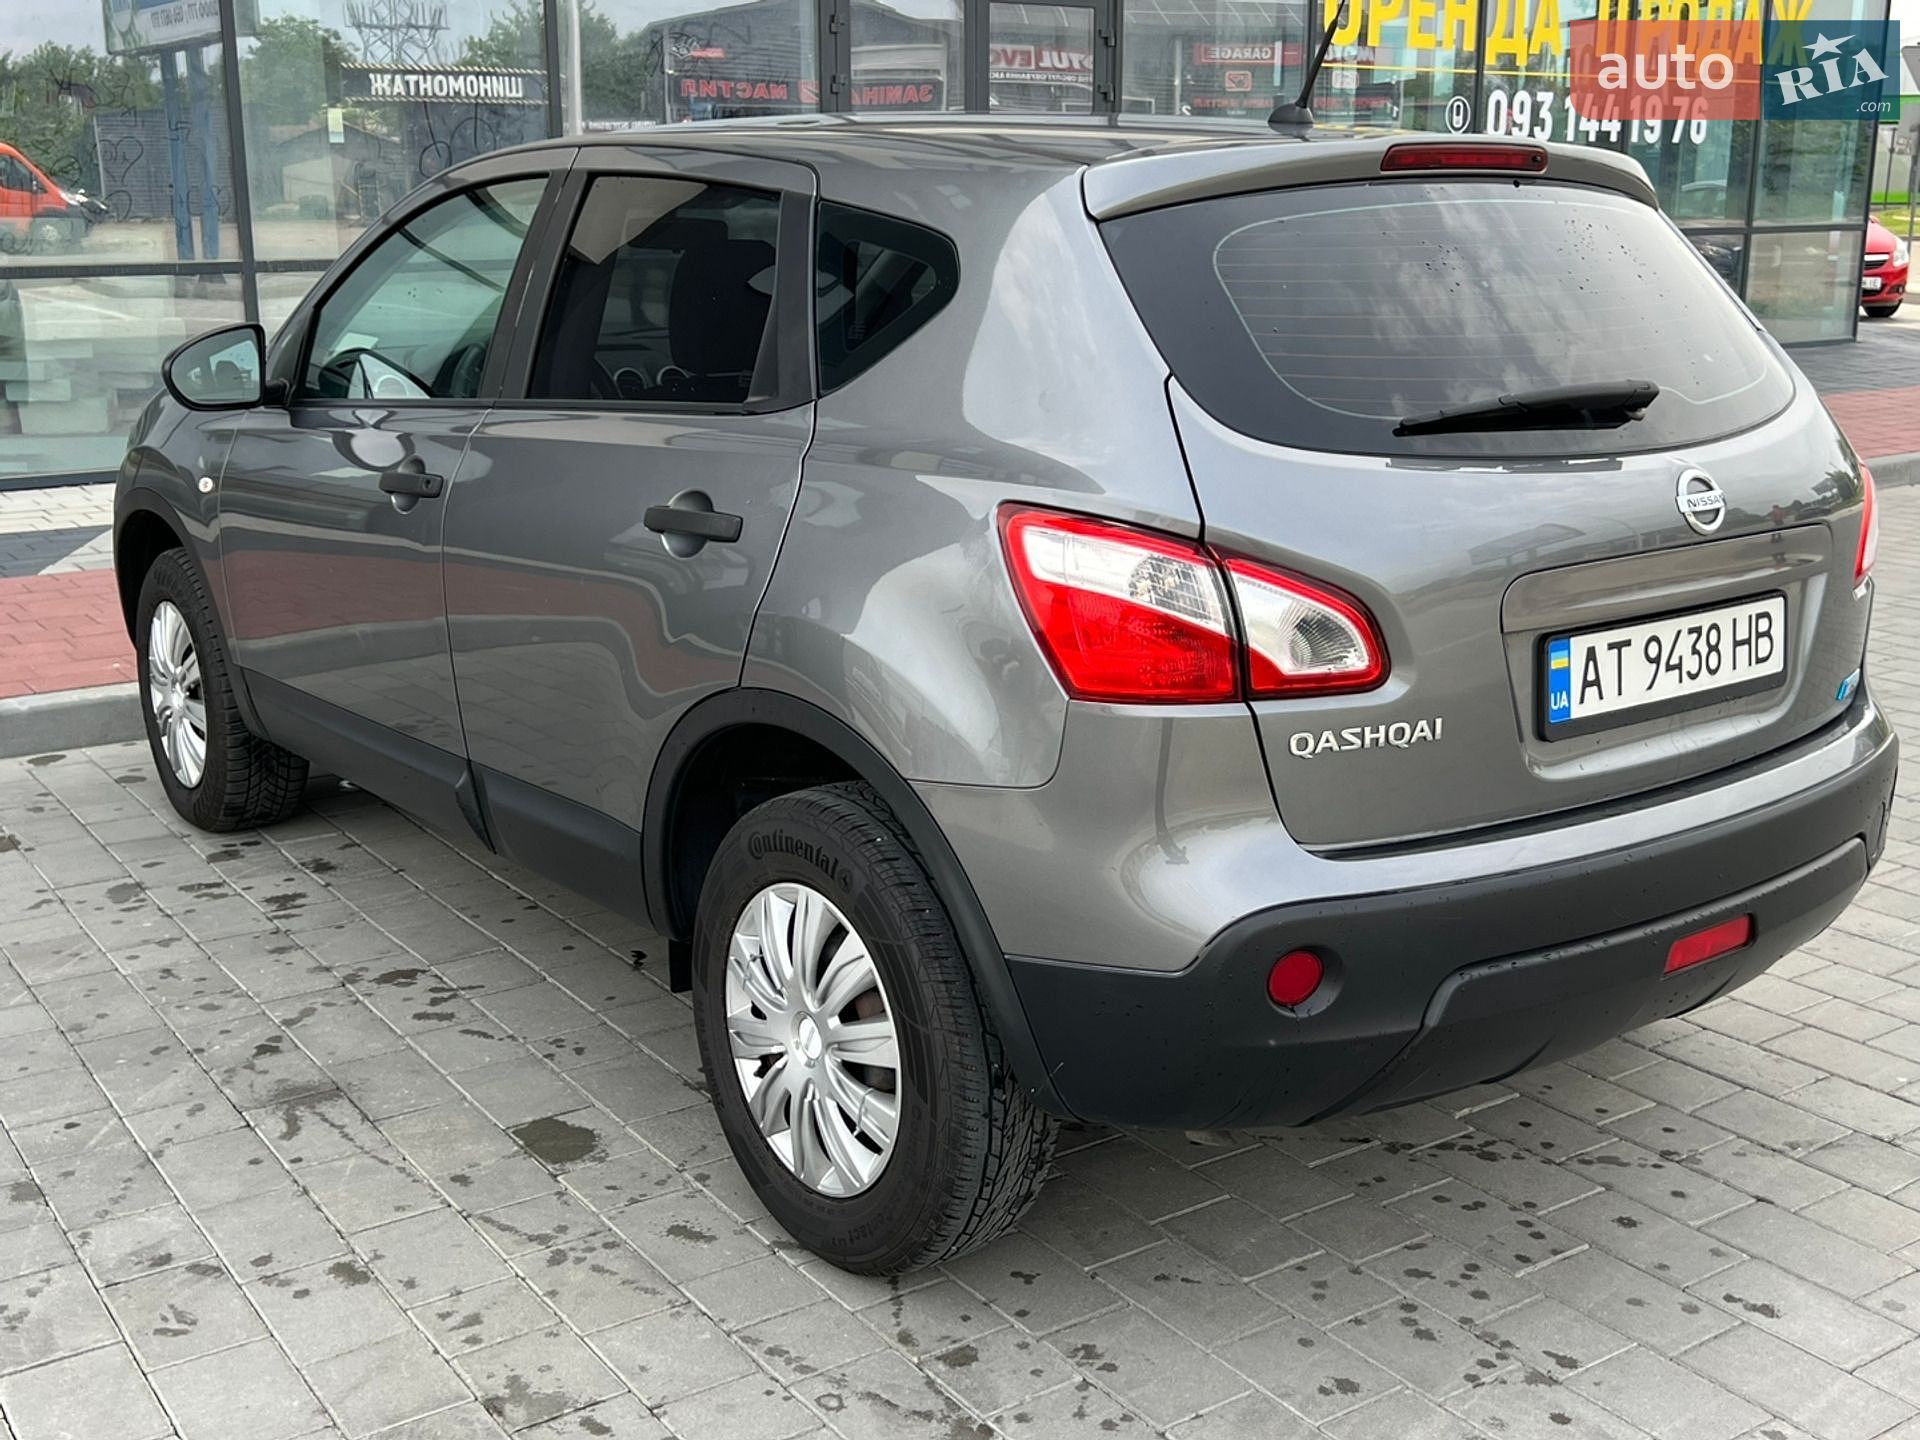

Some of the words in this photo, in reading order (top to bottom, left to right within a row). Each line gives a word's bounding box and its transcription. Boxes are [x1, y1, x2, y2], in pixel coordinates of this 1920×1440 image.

[1323, 0, 1562, 67] ОРЕНДА
[1486, 89, 1554, 142] 093
[1563, 92, 1623, 143] 144
[1629, 94, 1662, 144] 19
[1671, 96, 1708, 145] 76
[1578, 638, 1633, 705] AT
[1643, 620, 1723, 692] 9438
[1731, 610, 1776, 672] HB
[1551, 692, 1568, 710] UA
[1289, 717, 1443, 759] QASHQAI
[748, 829, 839, 881] Continental
